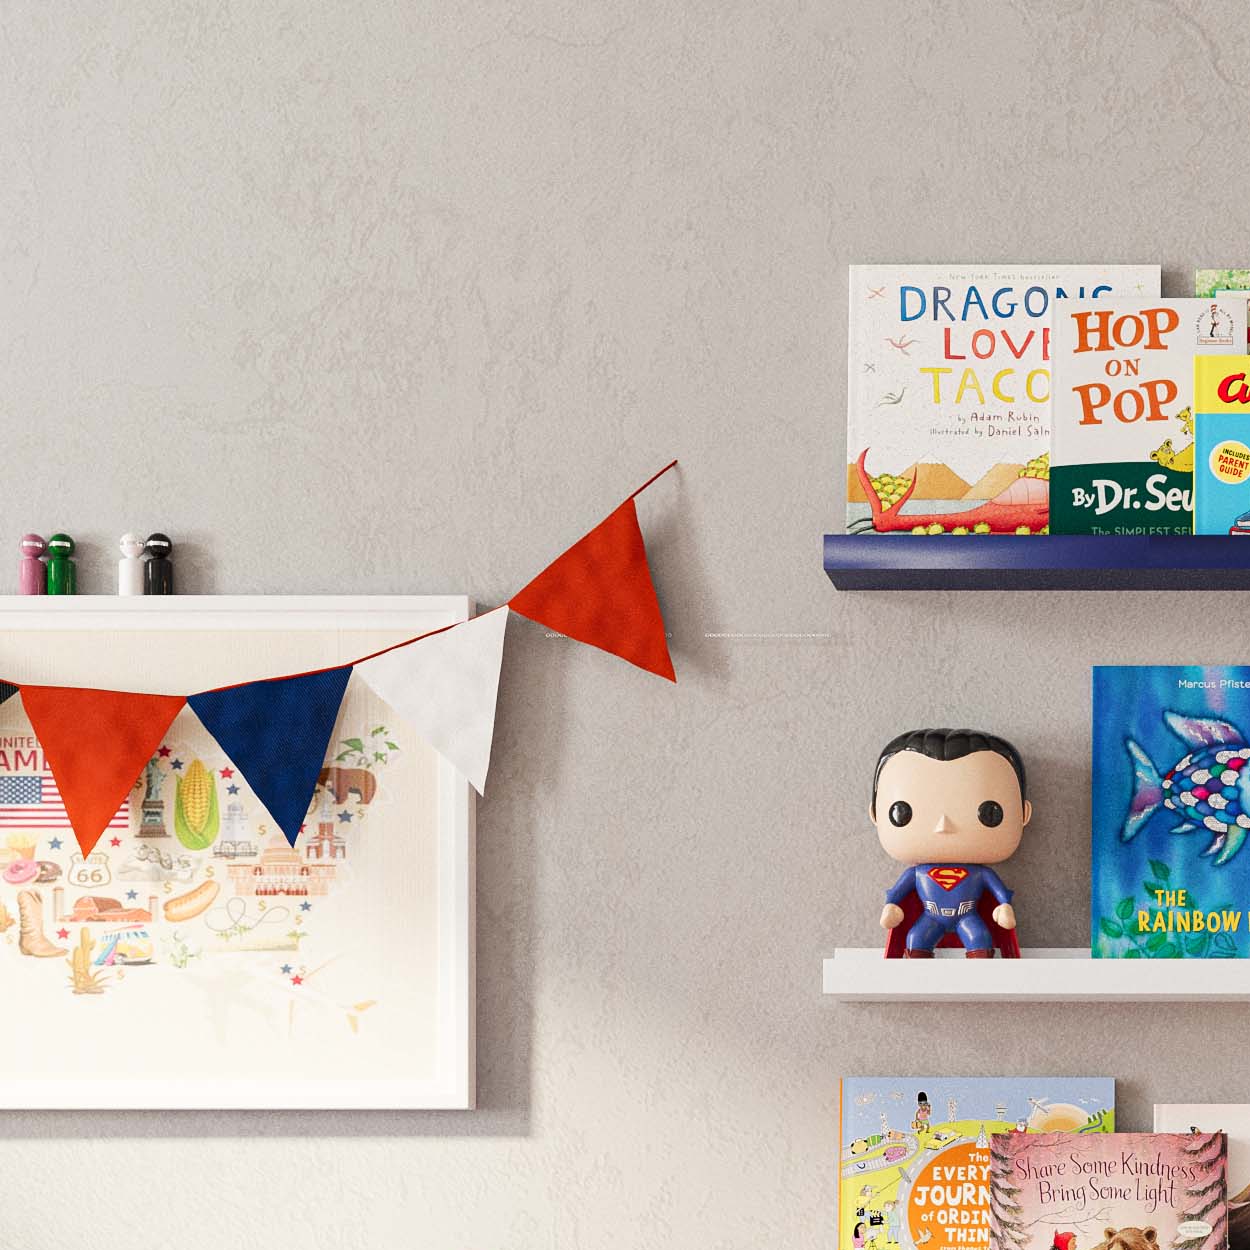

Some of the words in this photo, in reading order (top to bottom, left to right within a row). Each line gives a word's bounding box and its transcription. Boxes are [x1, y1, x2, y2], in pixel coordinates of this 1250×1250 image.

[1071, 308, 1180, 353] HOP
[1105, 358, 1141, 377] ON
[1072, 379, 1178, 425] POP
[970, 411, 1003, 422] Adam
[1008, 410, 1040, 423] Rubin
[988, 425, 1021, 437] Daniel
[1222, 447, 1250, 461] INCLUDES
[1218, 455, 1250, 470] PARENT
[1219, 465, 1243, 478] GUIDE
[1072, 488, 1095, 507] By
[1092, 479, 1141, 515] Dr.
[1178, 679, 1217, 689] Marcus
[77, 869, 103, 883] 66
[1154, 889, 1187, 907] THE
[1138, 911, 1242, 933] RAINBOW
[968, 1152, 989, 1162] The
[932, 1165, 990, 1181] EVERY
[1015, 1158, 1066, 1183] Share
[1070, 1152, 1117, 1178] Some
[1121, 1152, 1196, 1181] Kindness
[1039, 1180, 1087, 1211] Bring
[1089, 1177, 1133, 1201] Some
[1136, 1178, 1176, 1213] Light
[921, 1211, 935, 1222] of
[944, 1227, 989, 1242] THIN
